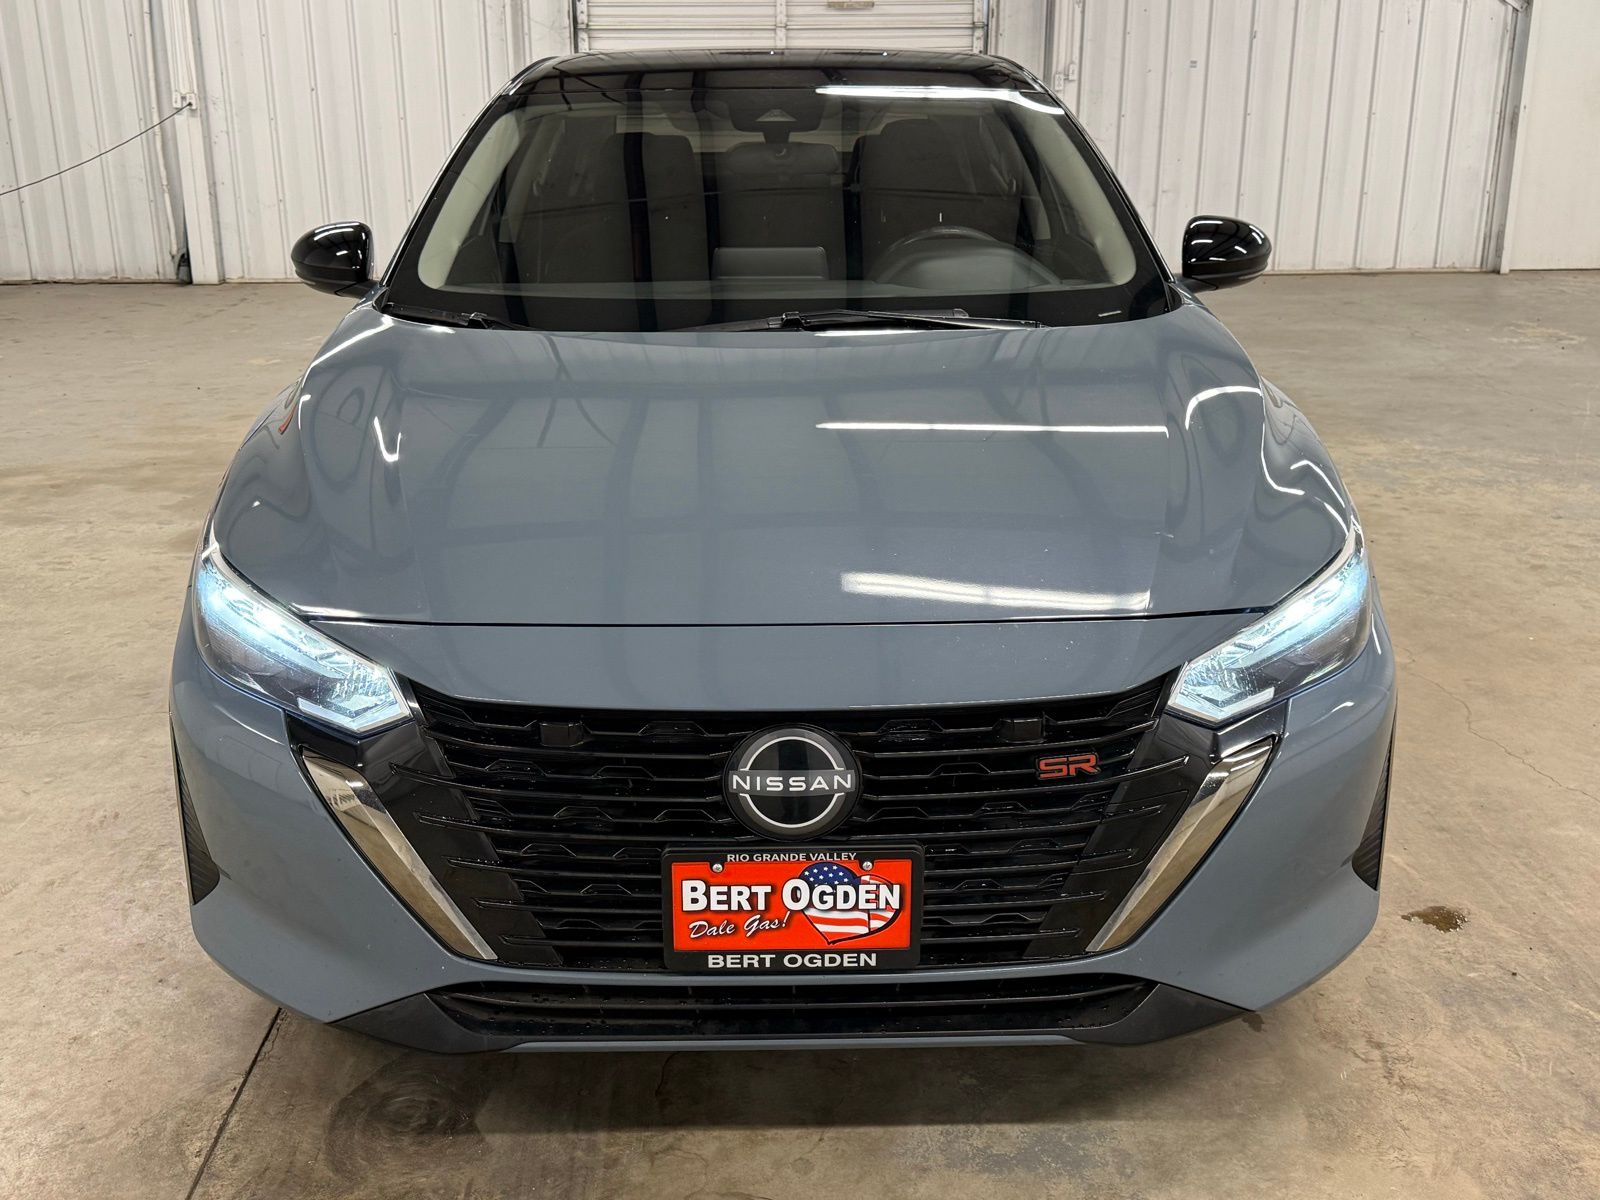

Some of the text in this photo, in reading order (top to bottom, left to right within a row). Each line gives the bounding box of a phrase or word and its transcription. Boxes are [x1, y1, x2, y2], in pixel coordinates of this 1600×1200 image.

[1038, 754, 1099, 779] SR
[732, 773, 851, 791] NISSAN
[726, 852, 856, 863] RIO GRANDE VALLEY
[681, 879, 900, 911] BERT OGDEN
[689, 910, 790, 938] Dale Gas!
[707, 953, 877, 969] BERT OGDEN
